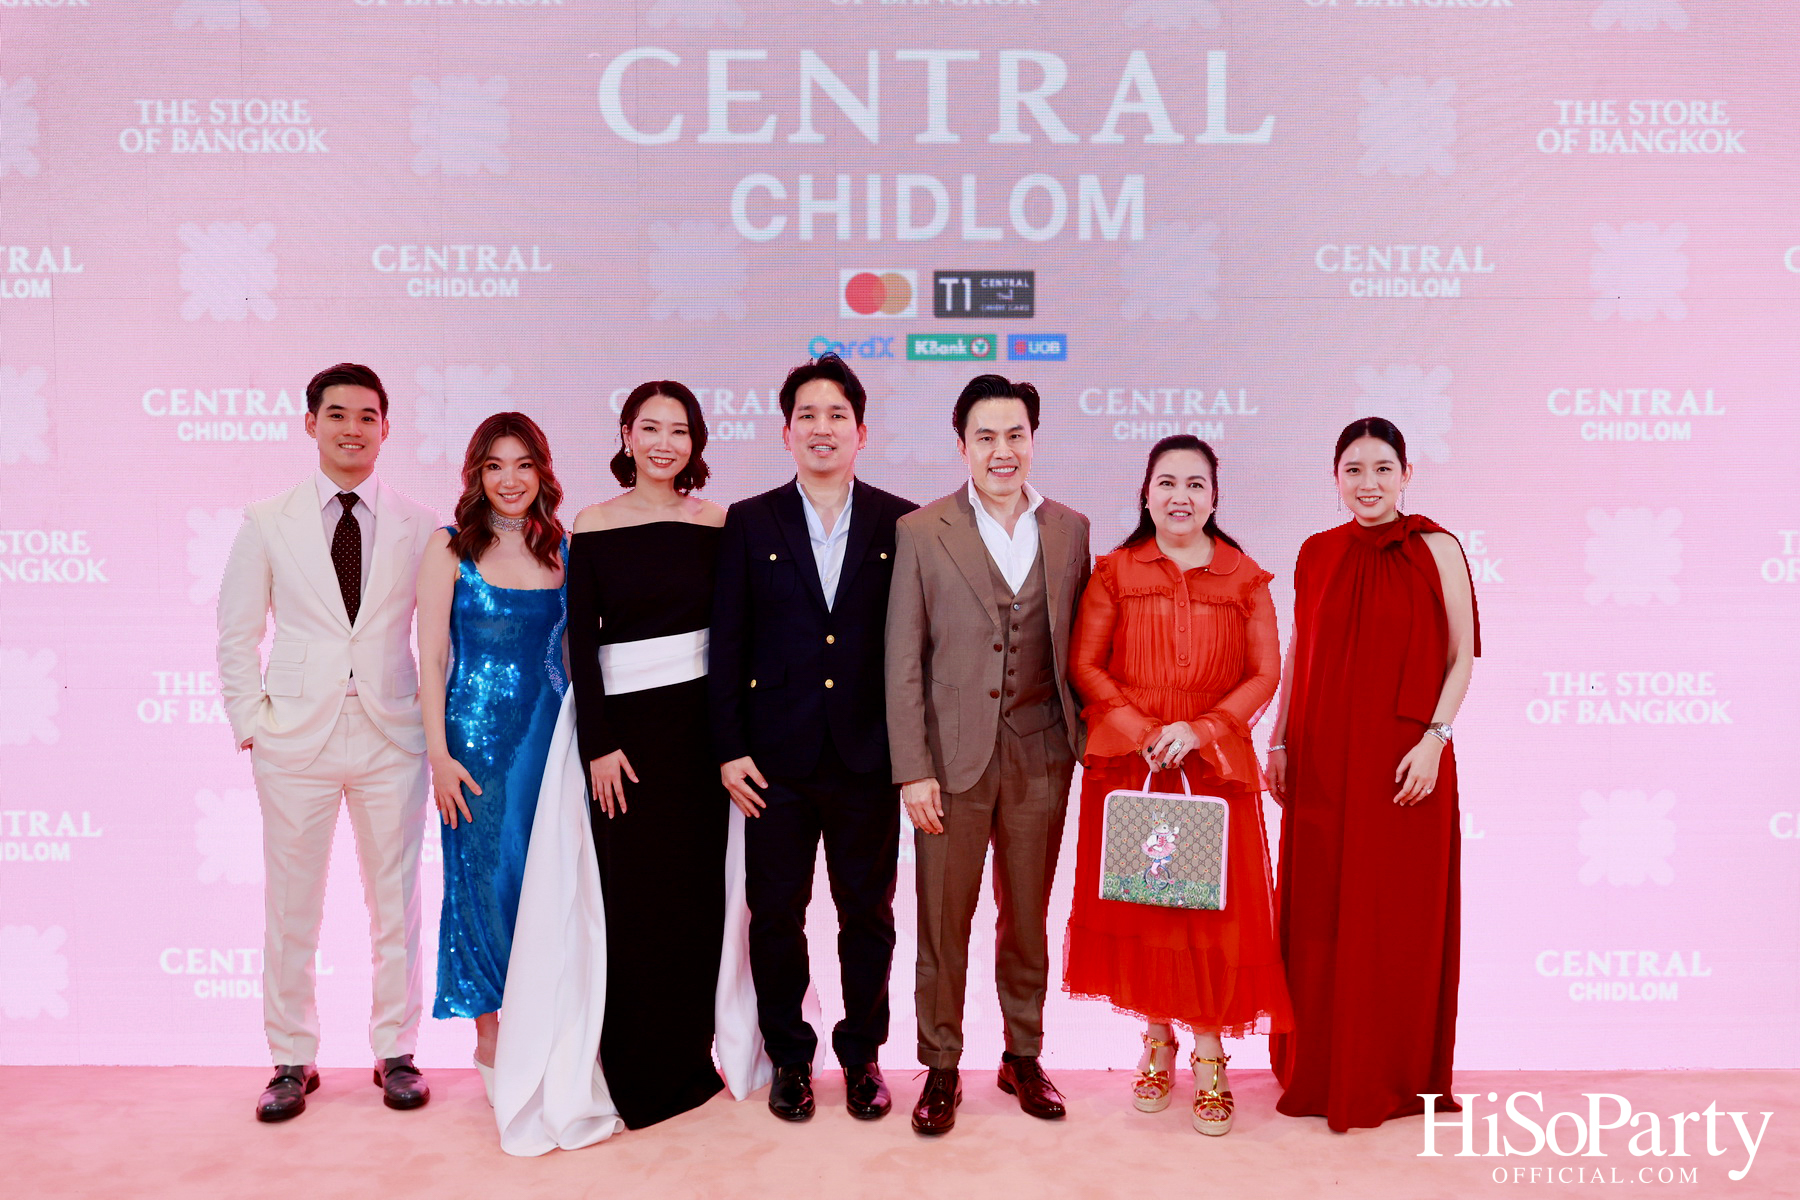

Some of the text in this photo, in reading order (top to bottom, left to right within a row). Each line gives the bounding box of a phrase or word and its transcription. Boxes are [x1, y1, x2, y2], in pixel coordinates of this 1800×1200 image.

[598, 46, 1276, 145] CENTRAL
[136, 98, 312, 125] THE STORE
[1554, 99, 1730, 126] THE STORE
[118, 128, 329, 154] OF BANGKOK
[1536, 128, 1746, 154] OF BANGKOK
[730, 173, 1145, 242] CHIDLOM
[371, 244, 552, 273] CENTRAL
[1315, 245, 1496, 273] CENTRAL
[406, 277, 519, 298] CHIDLOM
[939, 277, 971, 311] T1
[980, 277, 1030, 288] CENTRAL
[1349, 277, 1461, 298] CHIDLOM
[915, 340, 967, 355] KBank
[1029, 341, 1061, 354] UOB
[1078, 388, 1260, 416] CENTRAL
[1547, 388, 1726, 416] CENTRAL
[177, 421, 288, 442] CHIDLOM
[1580, 421, 1692, 442] CHIDLOM
[0, 558, 109, 583] NGKOK
[153, 671, 217, 696] THE
[1543, 671, 1716, 697] THE STORE
[137, 698, 180, 723] OF
[1525, 699, 1733, 725] OF BANGKOK
[0, 810, 104, 838] TRAL
[160, 947, 334, 975] CENTL
[1535, 949, 1712, 978] CENTRAL
[194, 979, 263, 999] CHIDL
[1568, 981, 1678, 1002] CHIDLOM
